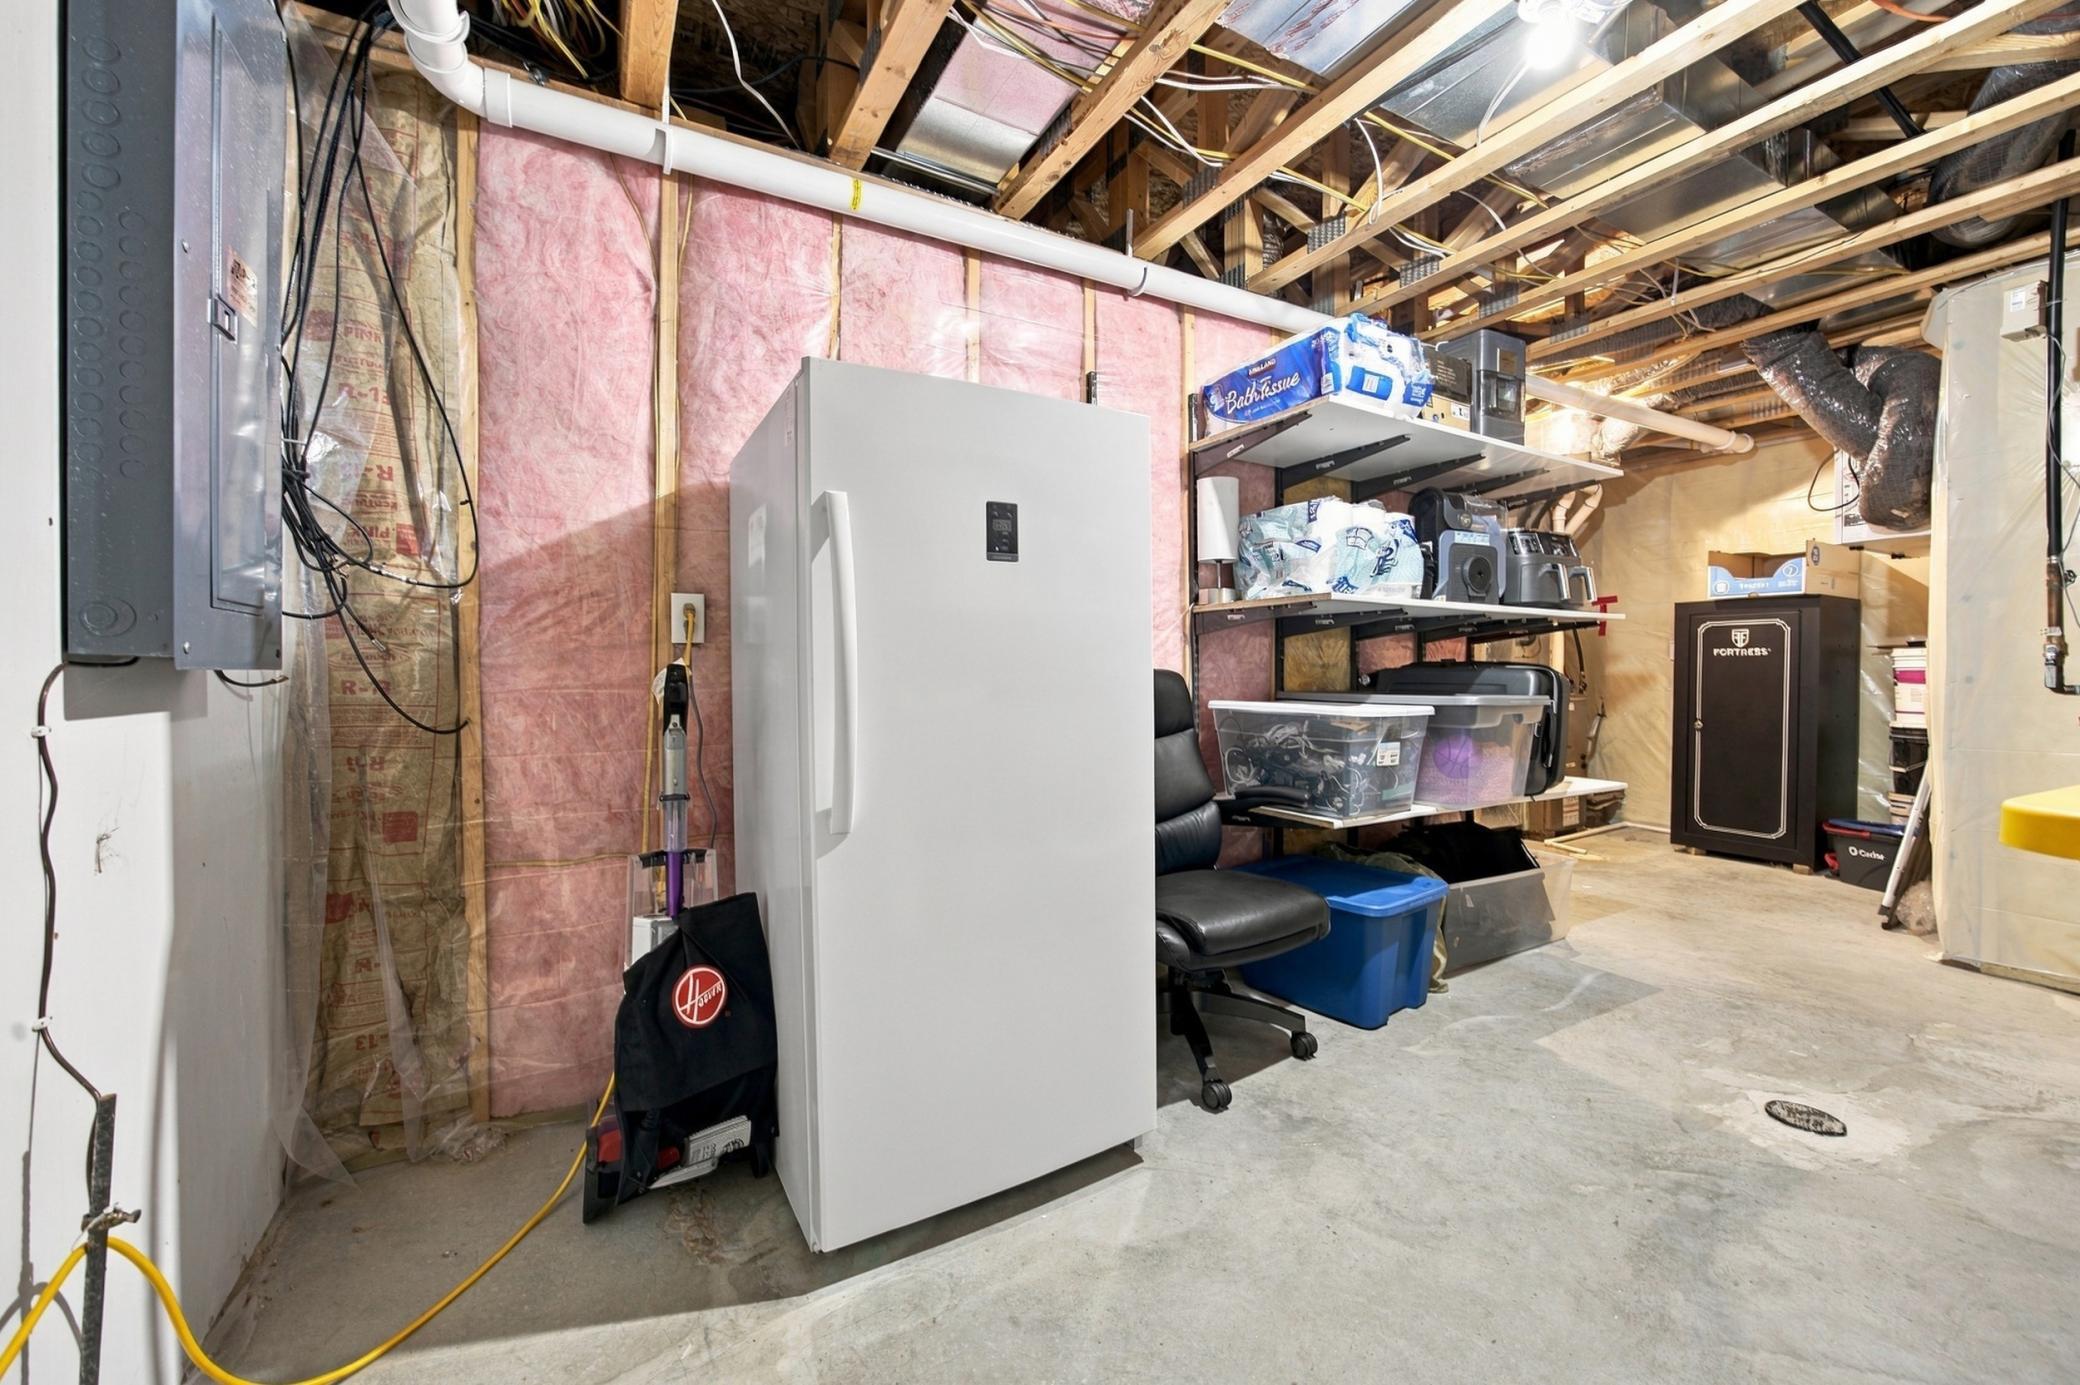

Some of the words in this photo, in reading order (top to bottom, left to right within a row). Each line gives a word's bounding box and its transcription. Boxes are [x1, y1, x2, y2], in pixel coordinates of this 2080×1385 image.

[1225, 381, 1260, 414] Bath
[1258, 372, 1300, 401] Tissue
[1713, 648, 1769, 657] FORTRESS
